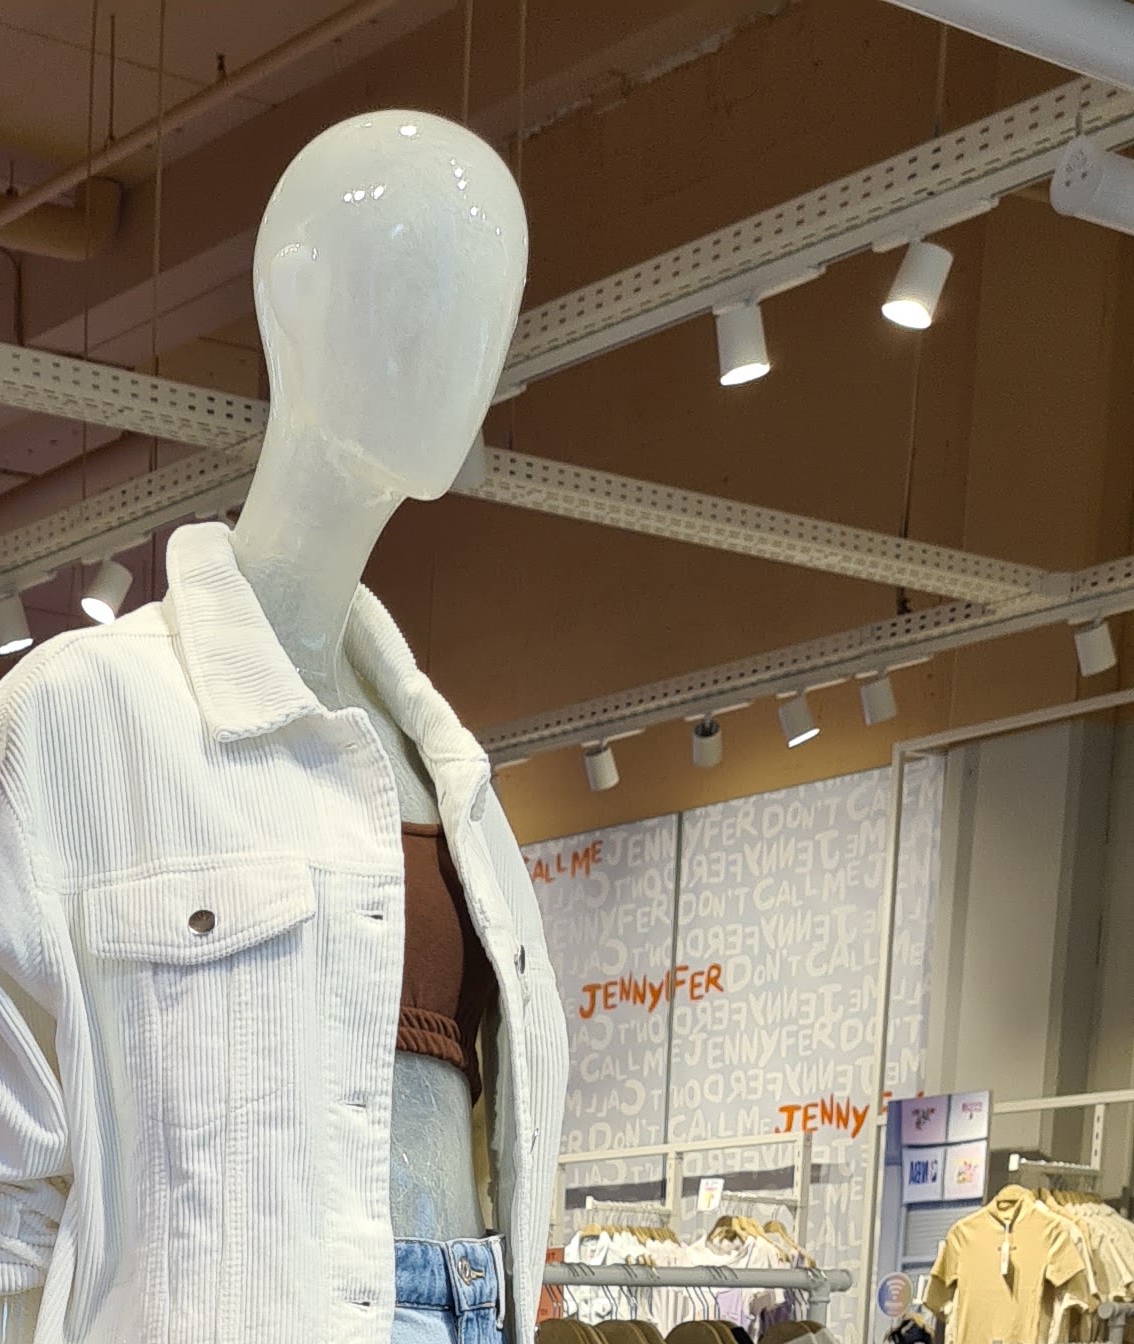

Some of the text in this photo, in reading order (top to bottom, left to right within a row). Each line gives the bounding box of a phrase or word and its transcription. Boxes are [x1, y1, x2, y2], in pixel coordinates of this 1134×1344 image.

[522, 853, 566, 884] ALL
[571, 839, 604, 879] ME
[579, 962, 725, 1020] JENNYFER
[774, 1093, 871, 1140] JENNY
